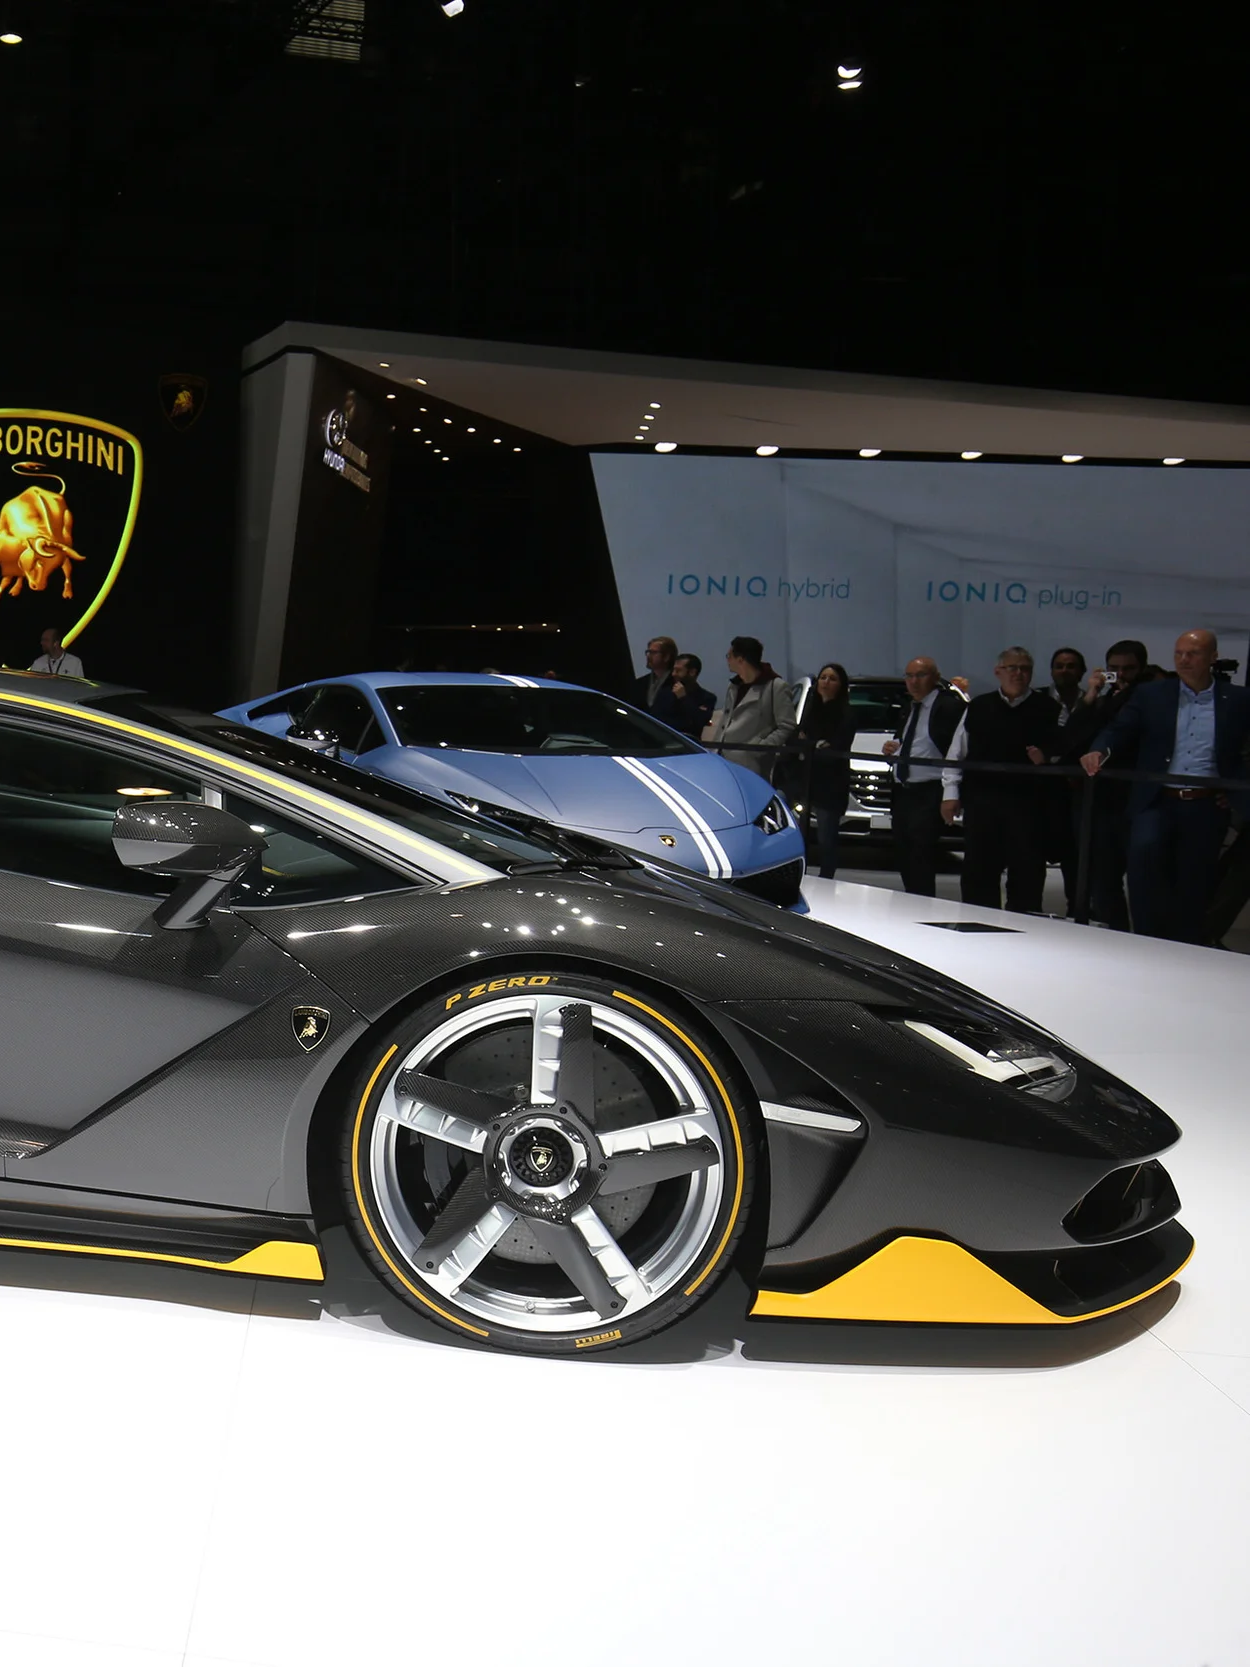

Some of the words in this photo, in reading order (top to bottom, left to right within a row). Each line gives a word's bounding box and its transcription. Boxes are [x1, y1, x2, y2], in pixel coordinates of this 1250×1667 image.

[667, 573, 768, 597] IONIQ
[778, 576, 850, 603] hybrid
[926, 580, 1028, 605] IONIQ
[1037, 584, 1122, 611] plug-in
[445, 992, 462, 1011] P
[467, 975, 551, 1000] ZERO
[574, 1328, 623, 1349] PIRELLI
